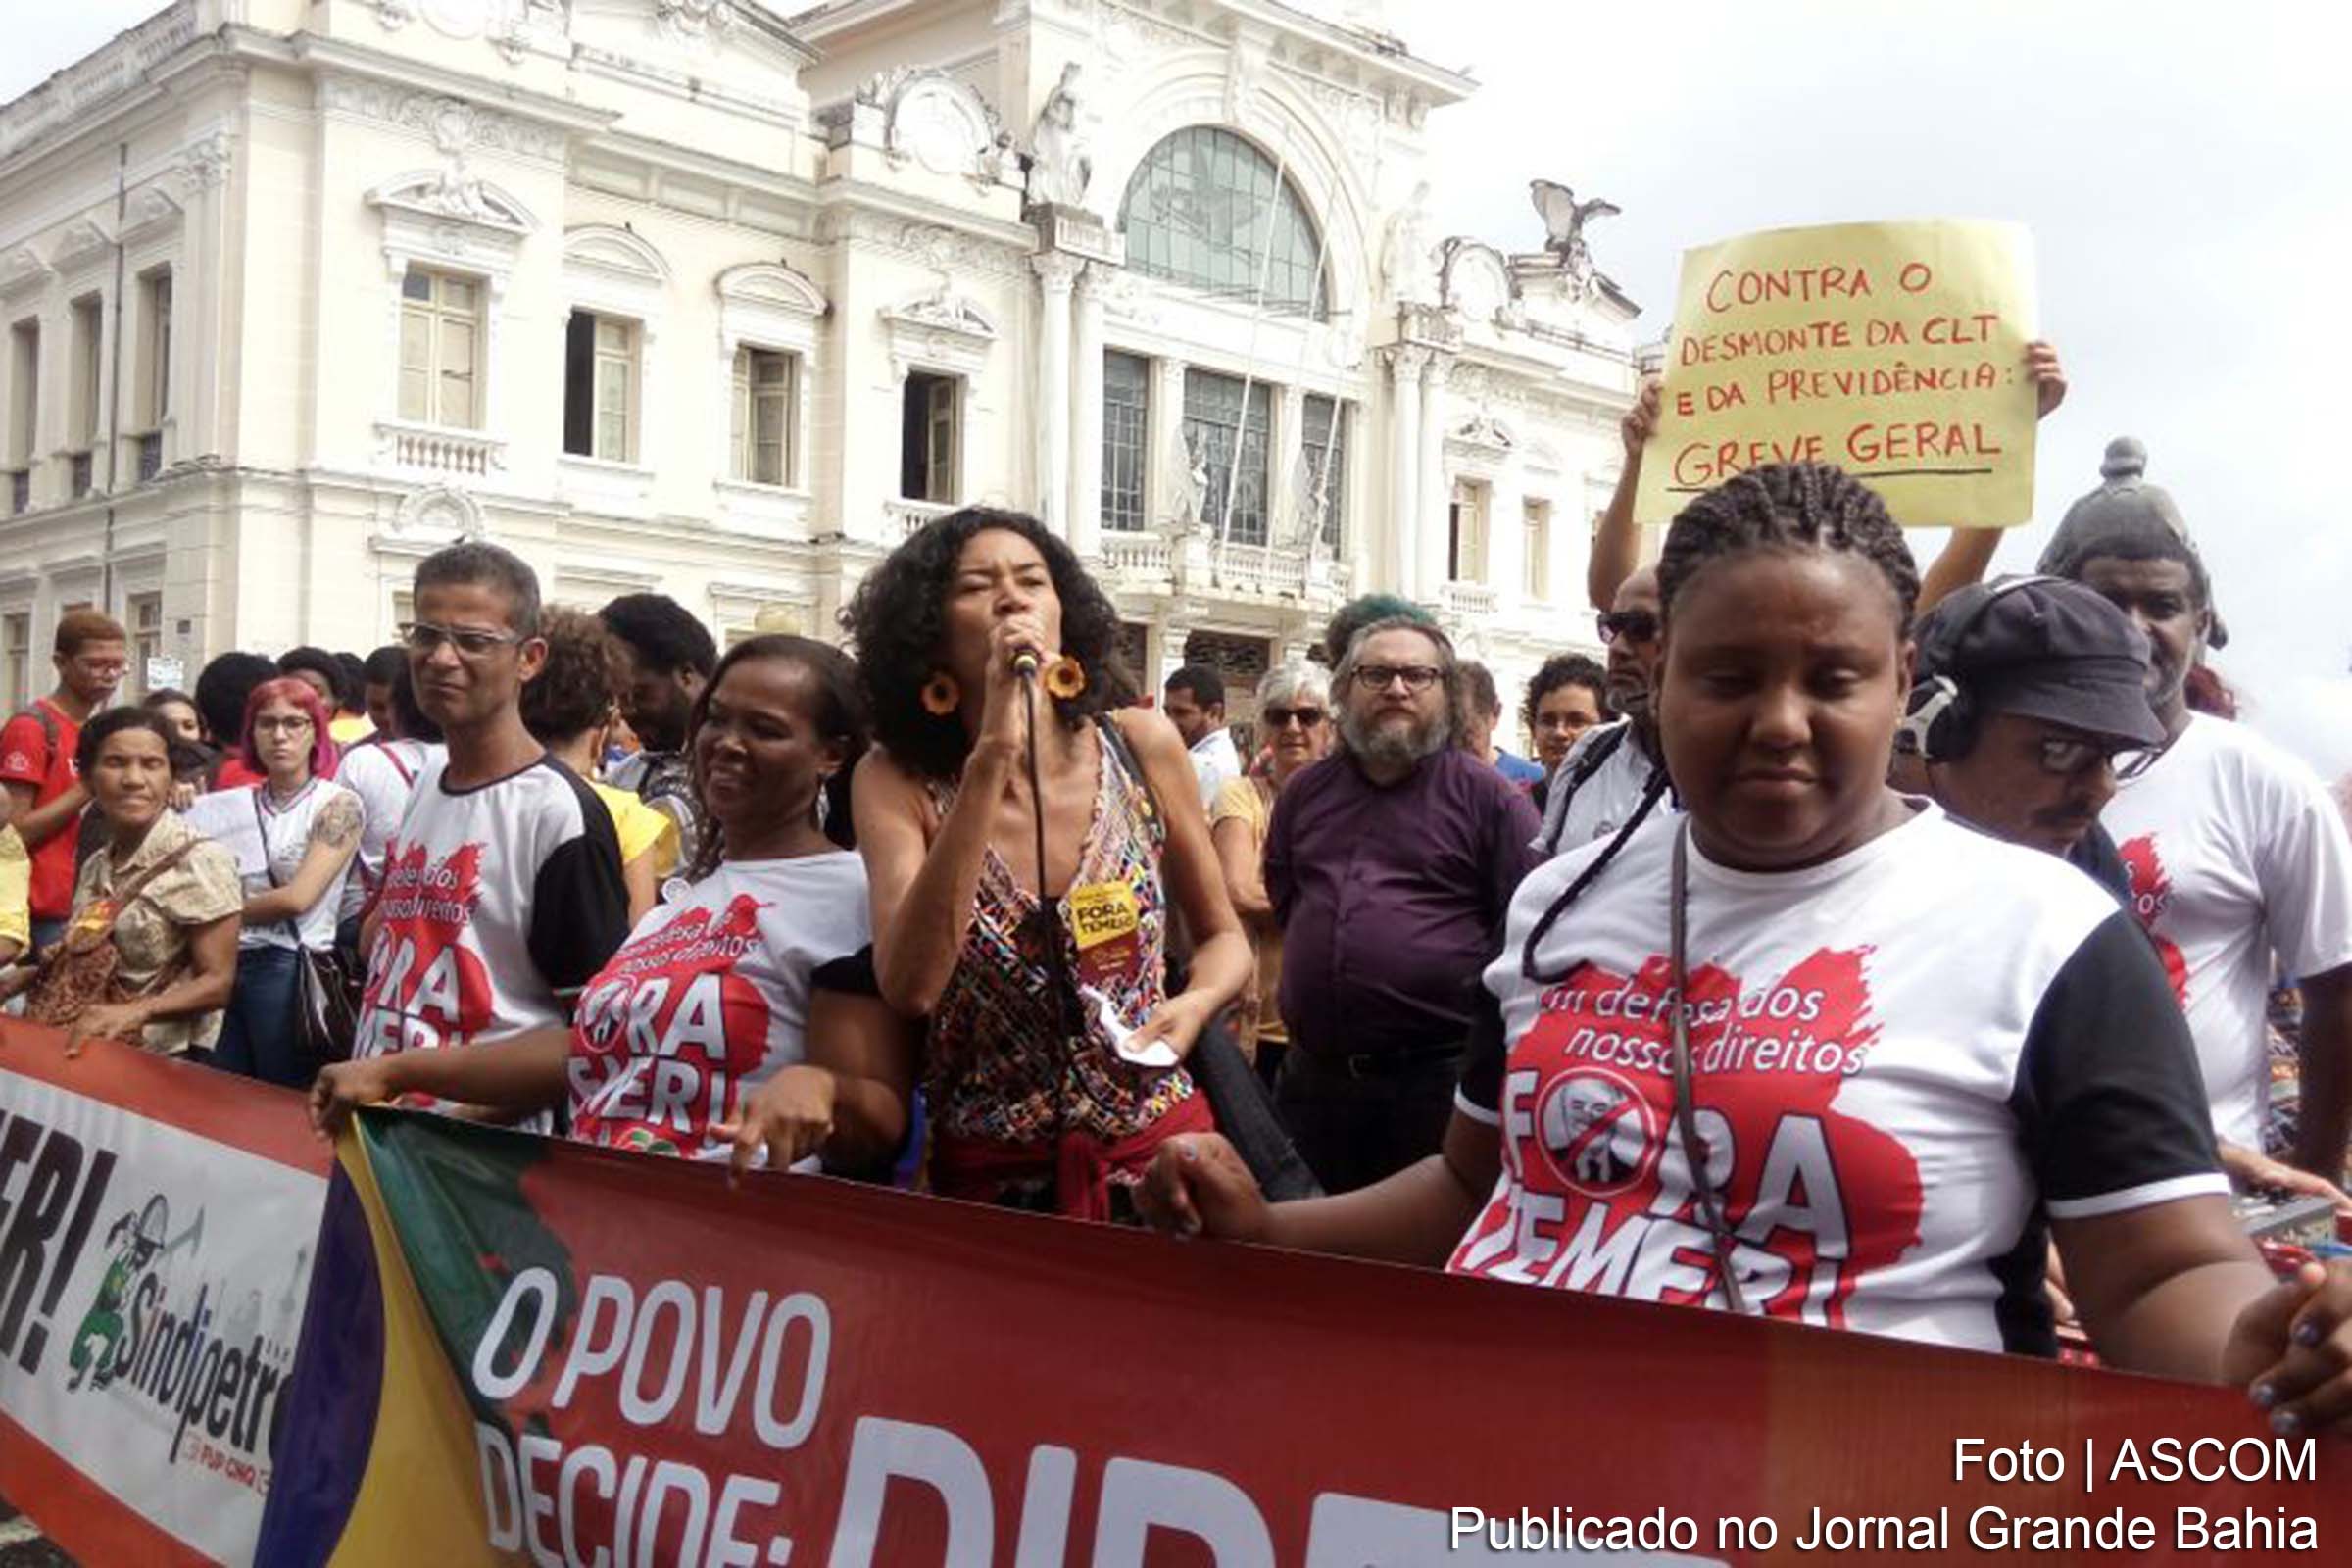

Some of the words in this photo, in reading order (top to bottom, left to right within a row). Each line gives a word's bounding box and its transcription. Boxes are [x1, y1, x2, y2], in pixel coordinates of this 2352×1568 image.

[1706, 267, 1871, 312] CONTRA
[1899, 263, 1932, 293] O
[1680, 321, 1851, 367] DESMONTE
[1866, 318, 1910, 347] DA
[1921, 314, 1998, 344] CLT
[1676, 392, 1696, 416] E
[1706, 382, 1746, 413] DA
[1767, 360, 2014, 404] PREVIDÊNCIA:
[1846, 421, 2002, 463] GERAL
[1702, 1021, 1869, 1076] direitos
[472, 1266, 558, 1399] O
[551, 1274, 832, 1450] POVO
